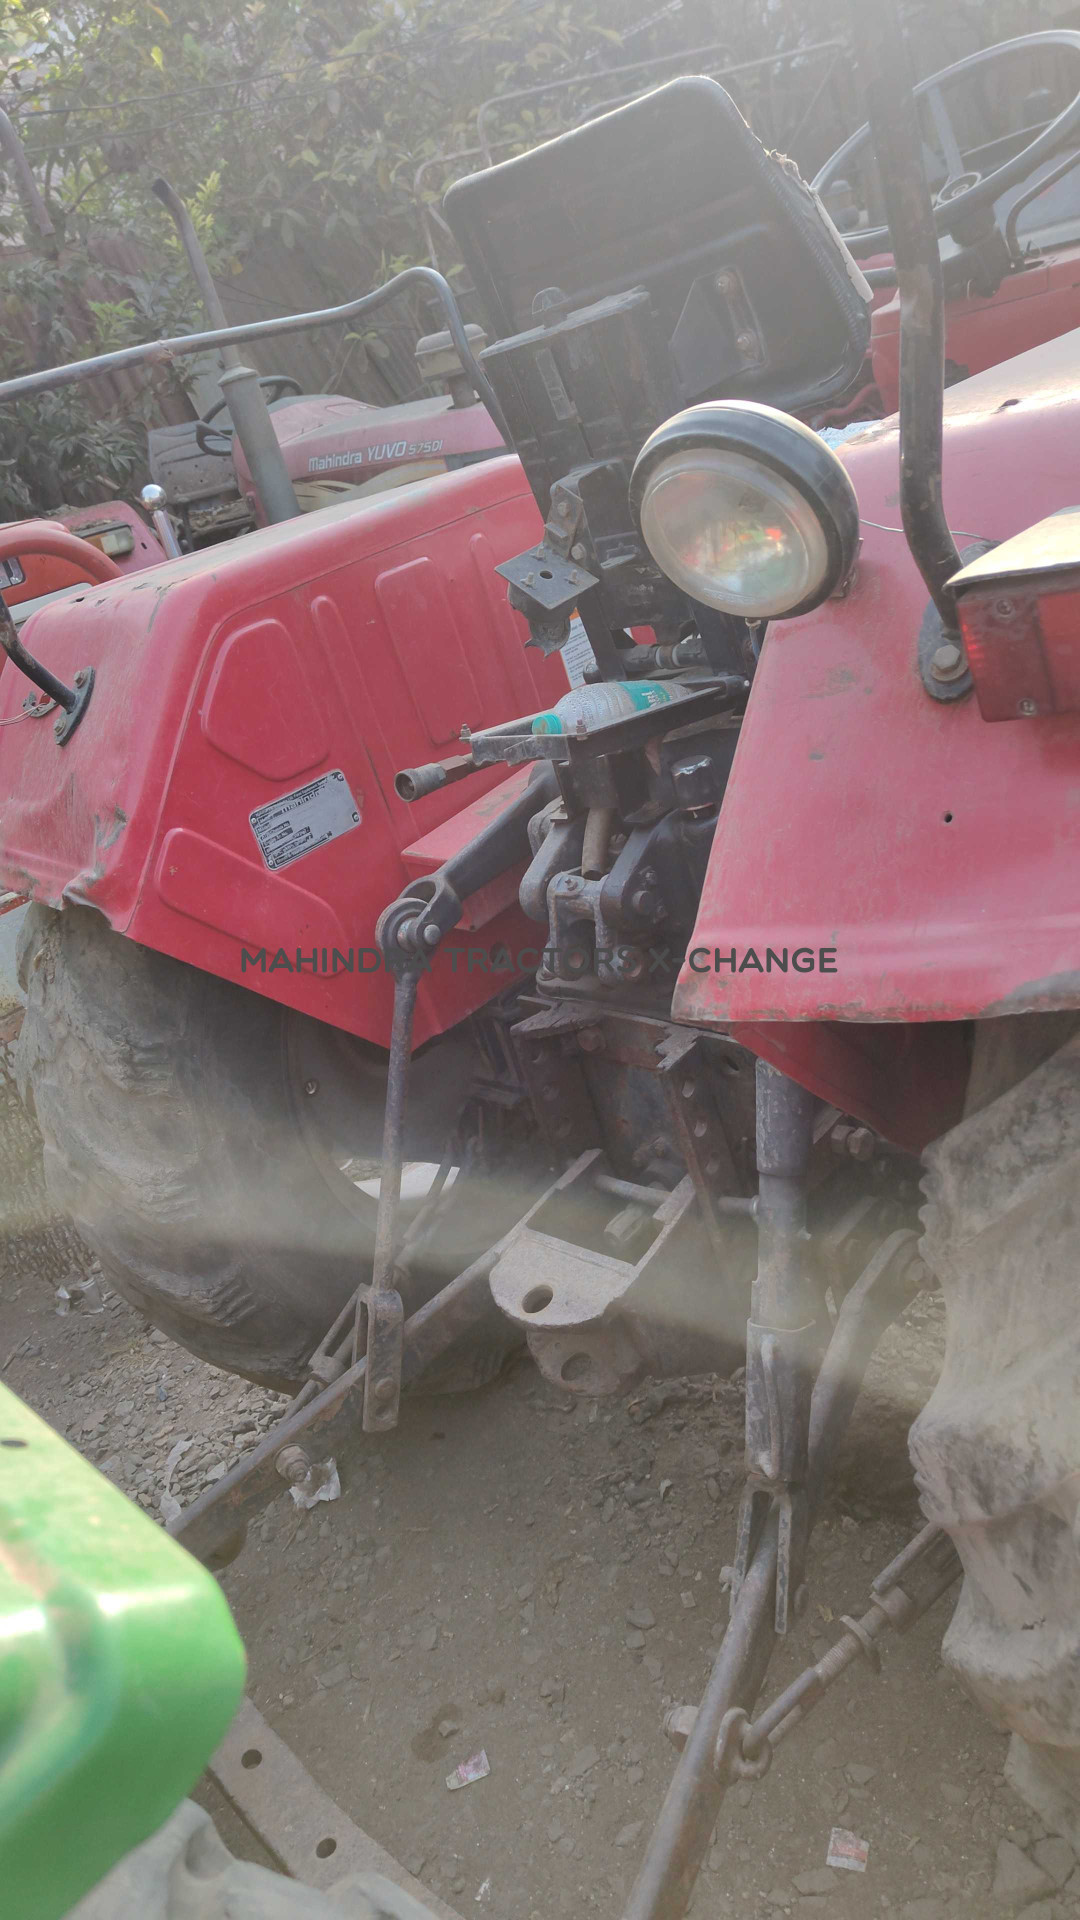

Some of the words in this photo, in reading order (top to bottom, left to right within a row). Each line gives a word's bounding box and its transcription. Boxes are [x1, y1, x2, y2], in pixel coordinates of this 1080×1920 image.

[308, 451, 362, 472] Mahindra
[367, 441, 407, 461] YUVO
[408, 440, 443, 455] 575DI
